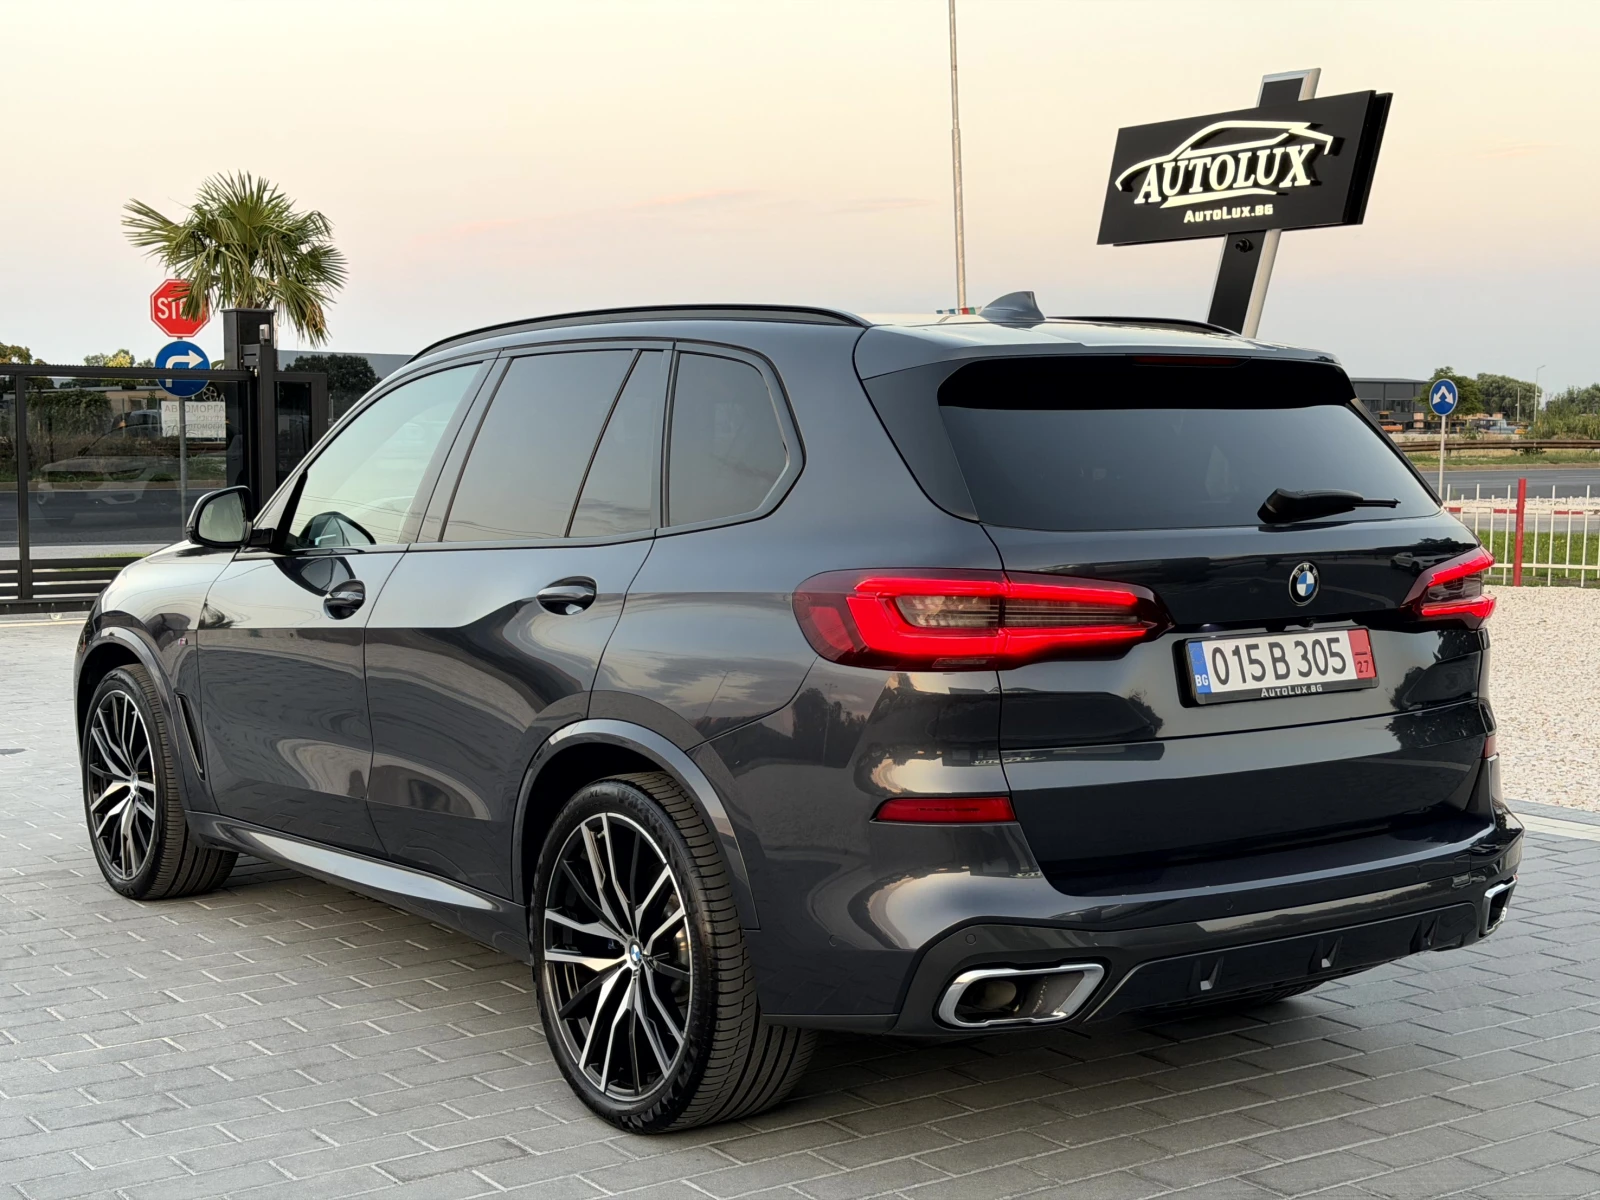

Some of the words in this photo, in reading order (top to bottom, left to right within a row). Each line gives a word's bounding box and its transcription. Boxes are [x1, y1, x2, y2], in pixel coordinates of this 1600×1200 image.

[1133, 143, 1316, 205] AUTOLUX
[1357, 660, 1370, 674] 27
[1195, 674, 1209, 687] BG
